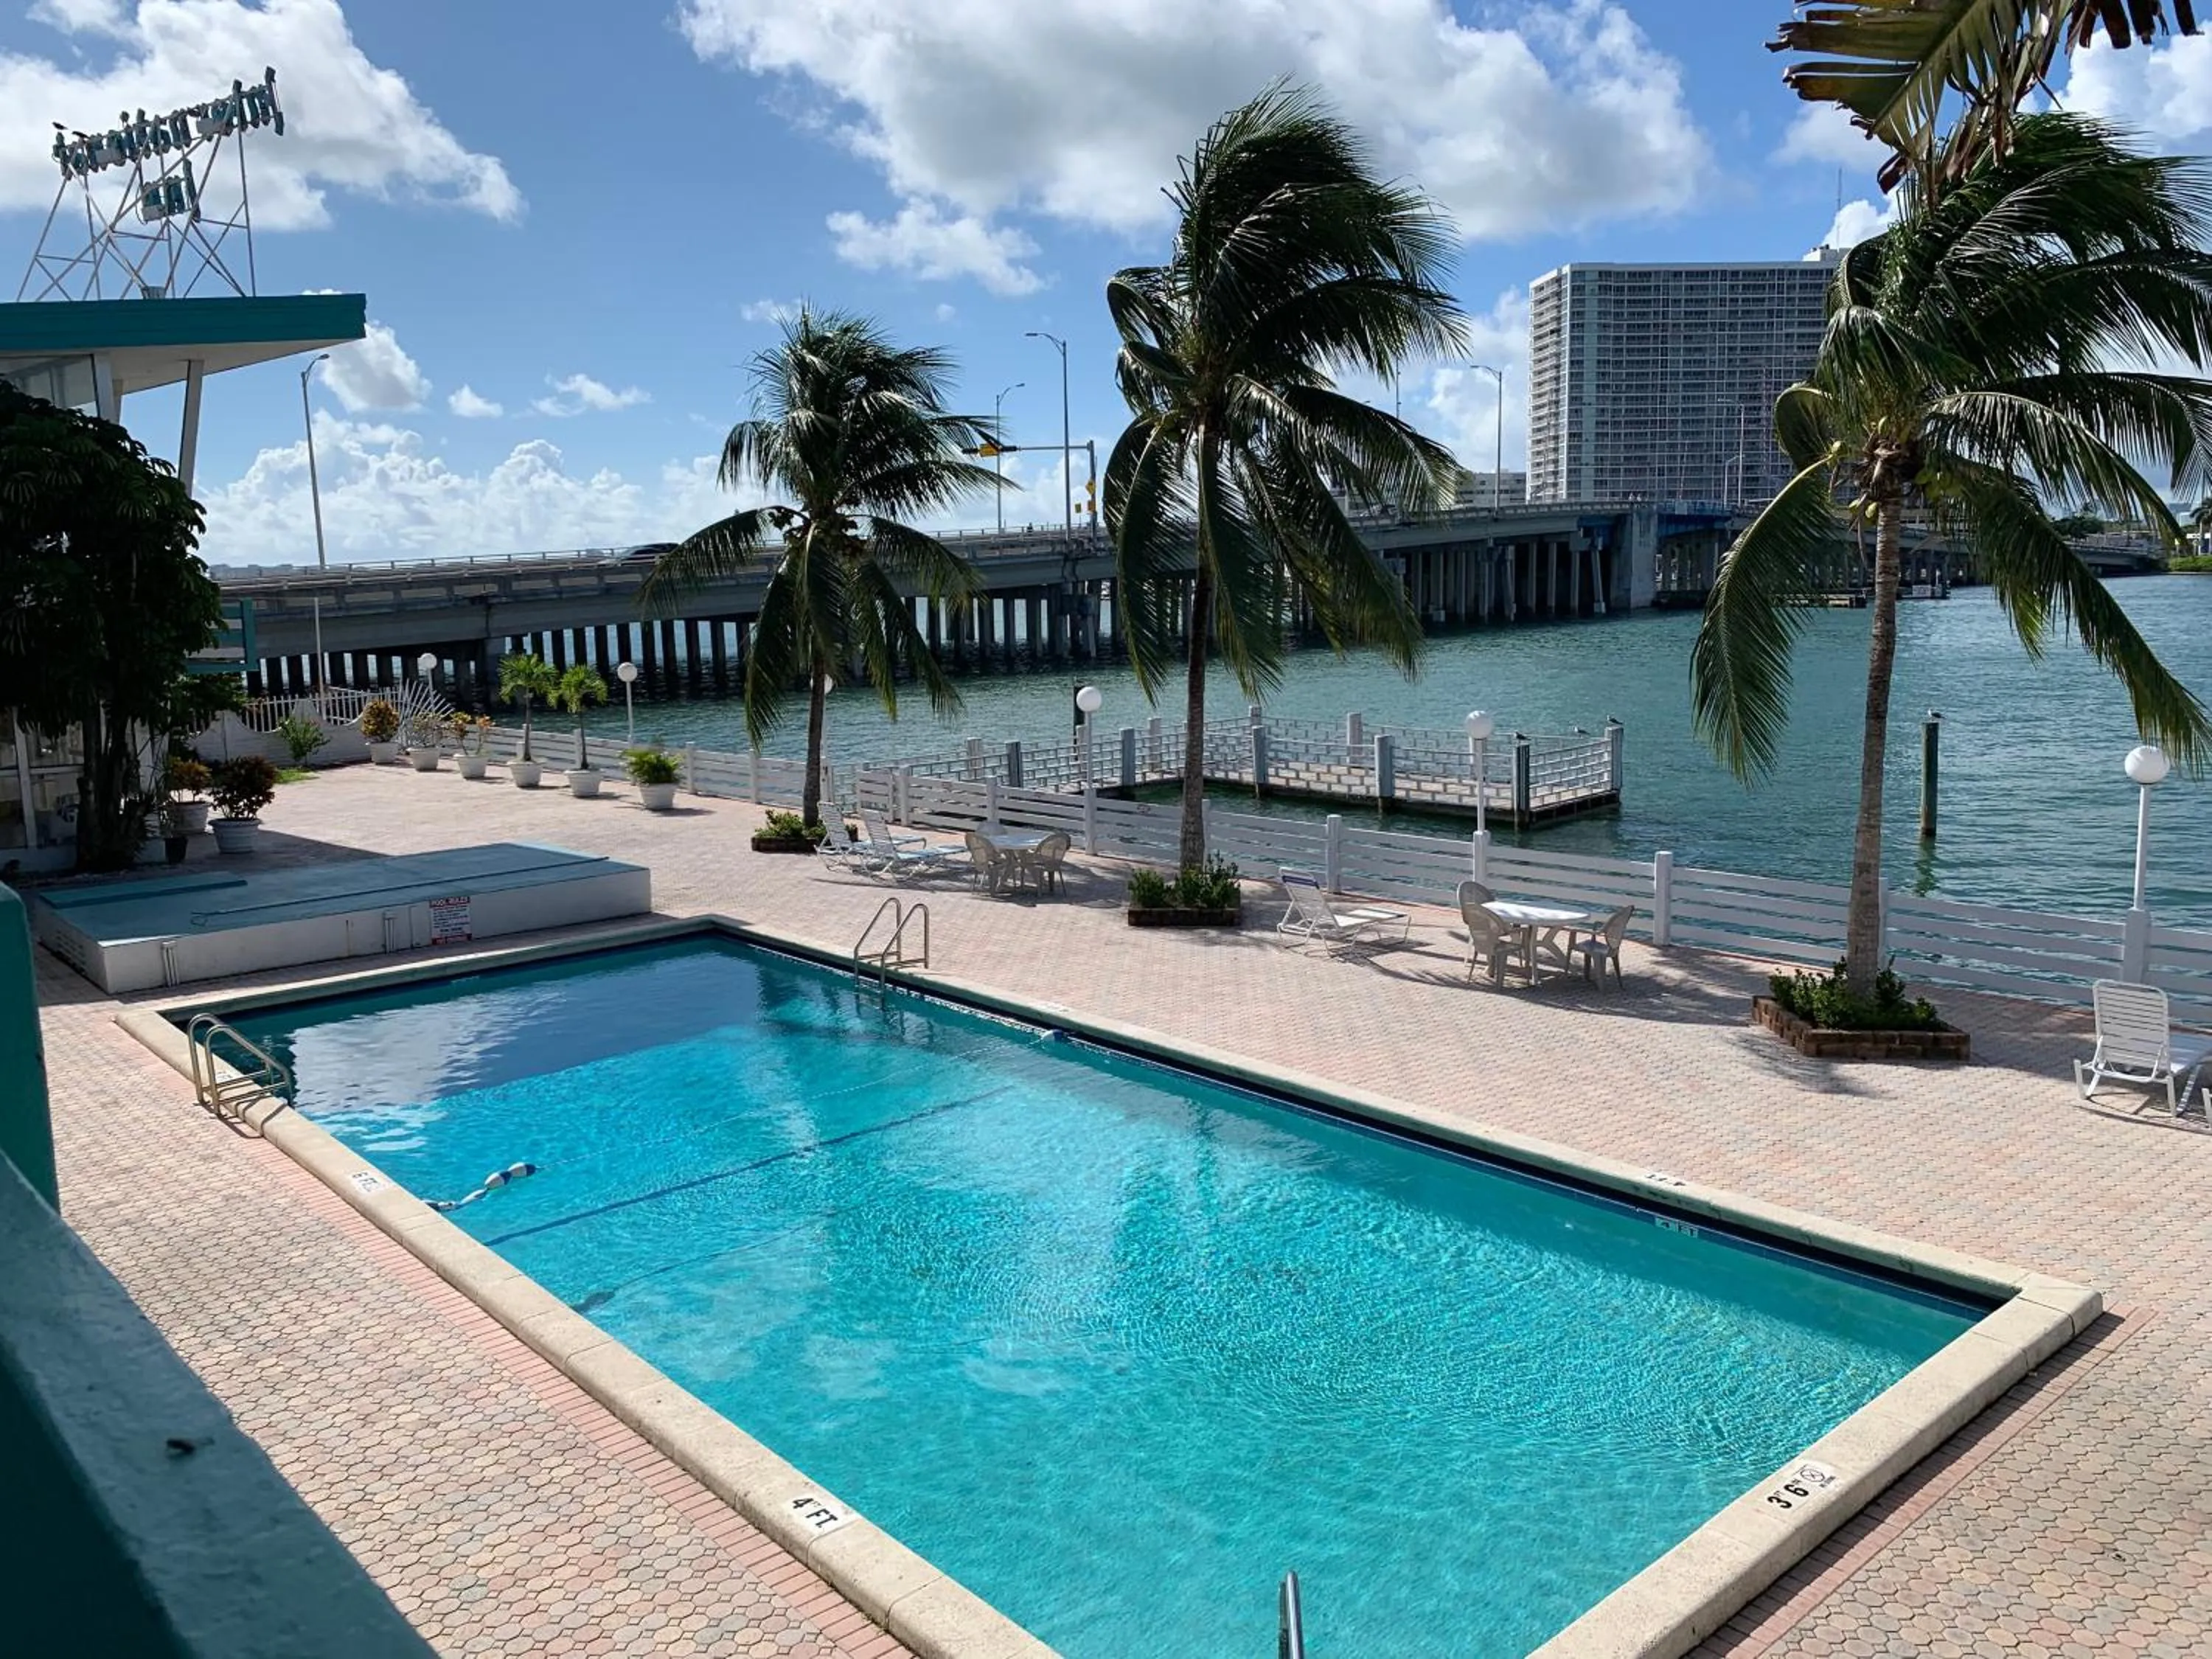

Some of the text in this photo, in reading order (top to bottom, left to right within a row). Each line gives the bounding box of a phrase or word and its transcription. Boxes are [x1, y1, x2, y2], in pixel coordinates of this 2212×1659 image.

[793, 1498, 813, 1509] 4
[1767, 1495, 1792, 1509] 3
[1784, 1484, 1809, 1497] 6
